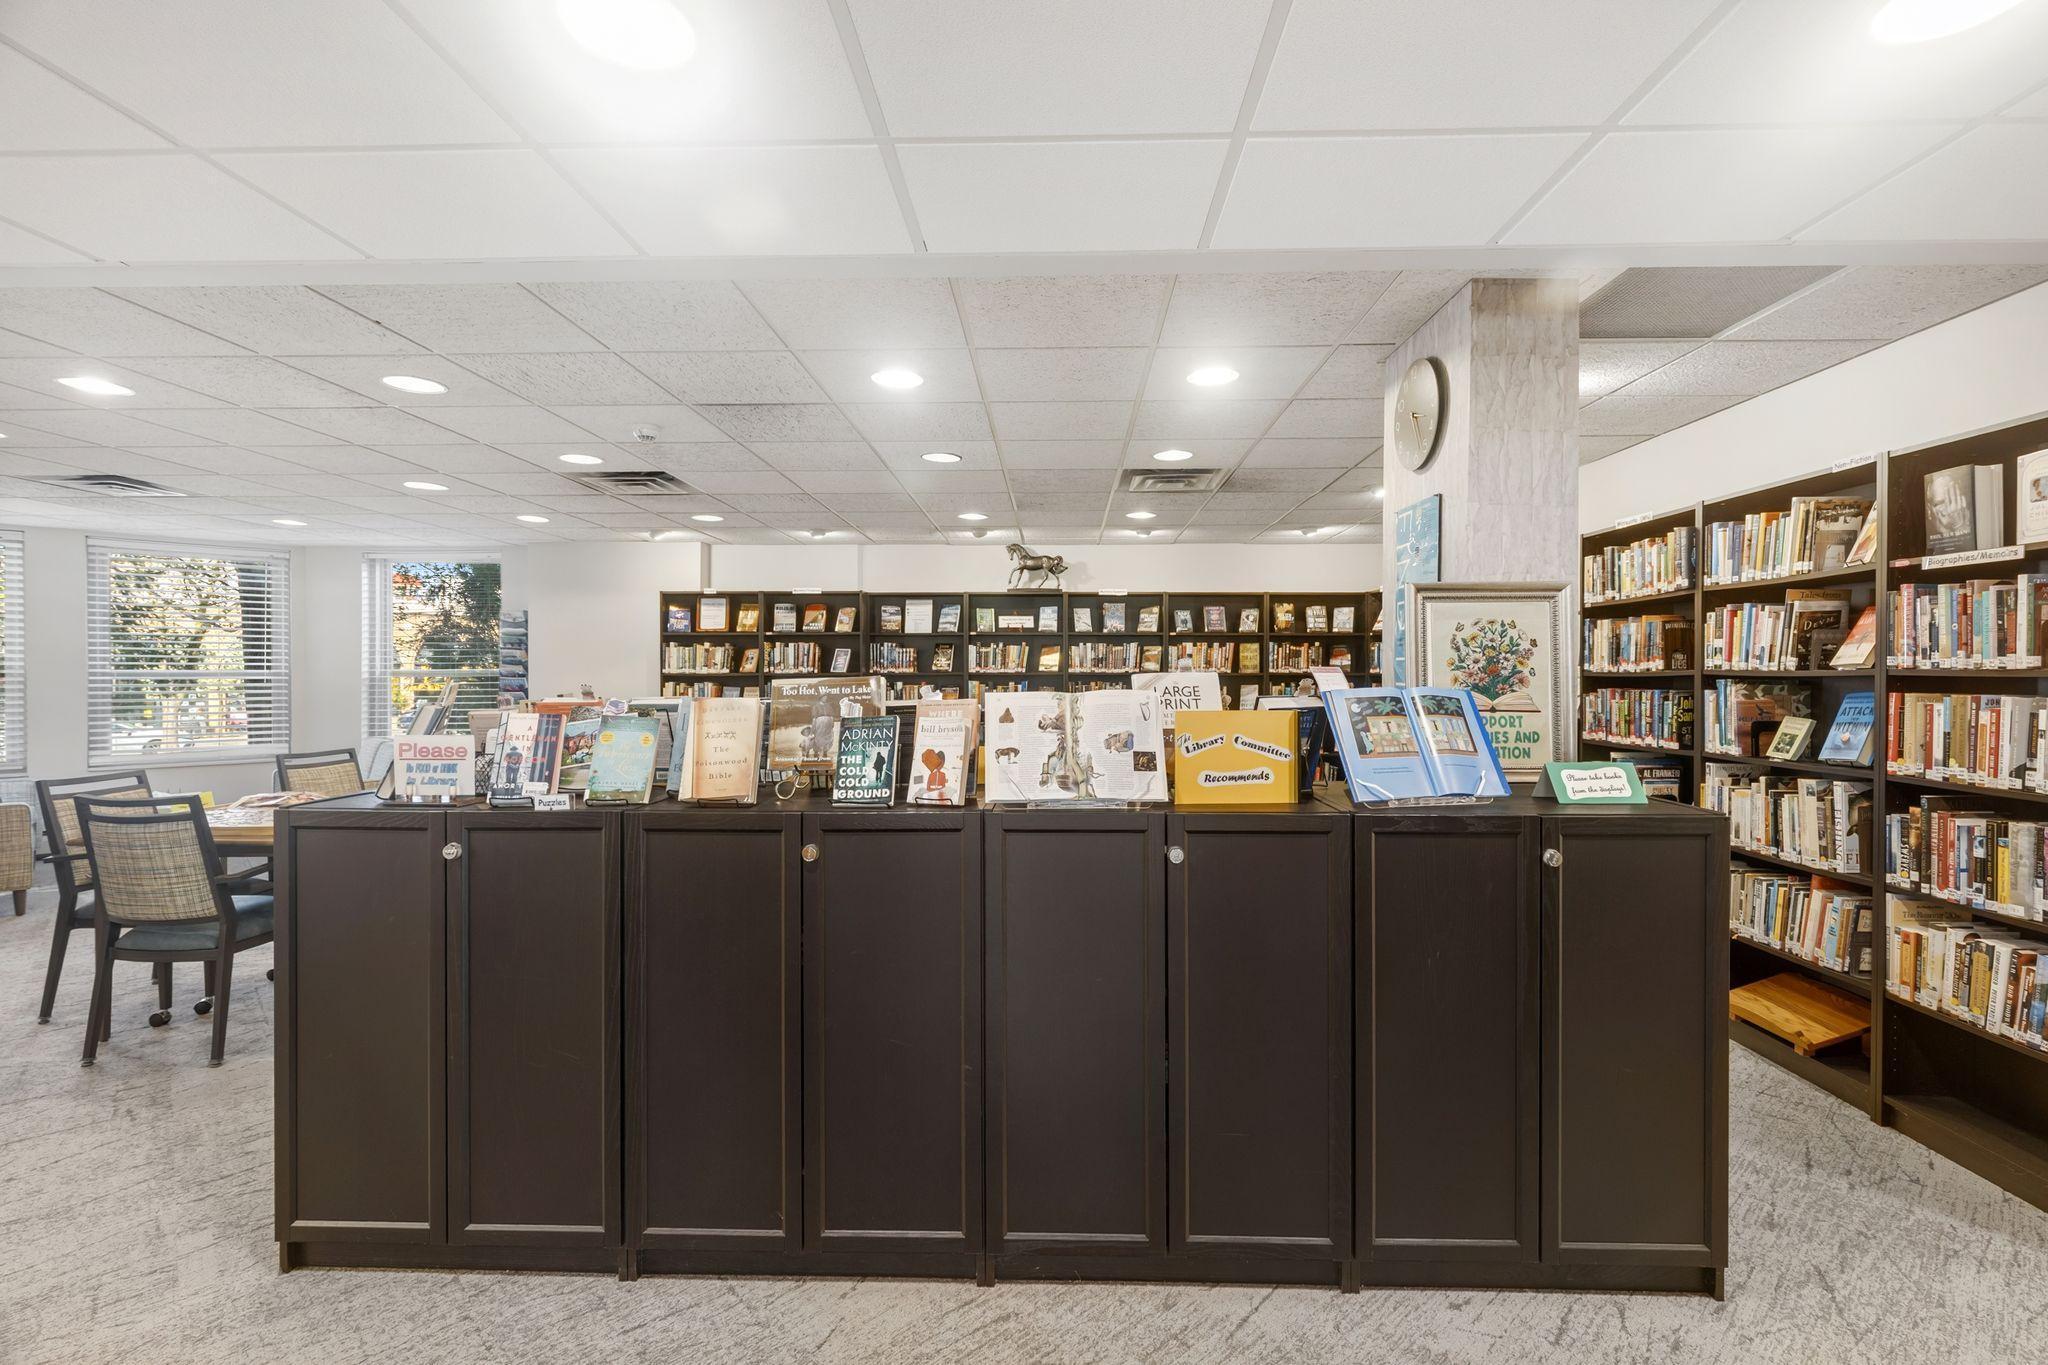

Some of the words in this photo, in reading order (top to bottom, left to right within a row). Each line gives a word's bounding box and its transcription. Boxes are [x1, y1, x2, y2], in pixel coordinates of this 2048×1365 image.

[782, 688, 797, 696] Too
[799, 686, 818, 695] Hot,
[818, 686, 840, 694] Went
[842, 686, 851, 694] to
[852, 685, 872, 694] Lake
[842, 728, 894, 740] ADRIAN
[920, 724, 936, 733] bill
[1177, 734, 1191, 748] The
[1514, 730, 1540, 744] AND
[398, 742, 468, 758] Please
[842, 740, 894, 752] McKINTY
[1185, 736, 1225, 754] Library
[1234, 736, 1291, 759] Committee
[696, 757, 748, 766] Poisonwood
[840, 755, 862, 764] THE
[708, 772, 732, 780] Bible
[840, 766, 870, 776] COLD
[1204, 770, 1270, 783] Recommends
[420, 776, 458, 786] Library
[838, 778, 870, 788] COLD
[838, 788, 890, 799] GROUND
[538, 799, 566, 807] Puzzles
